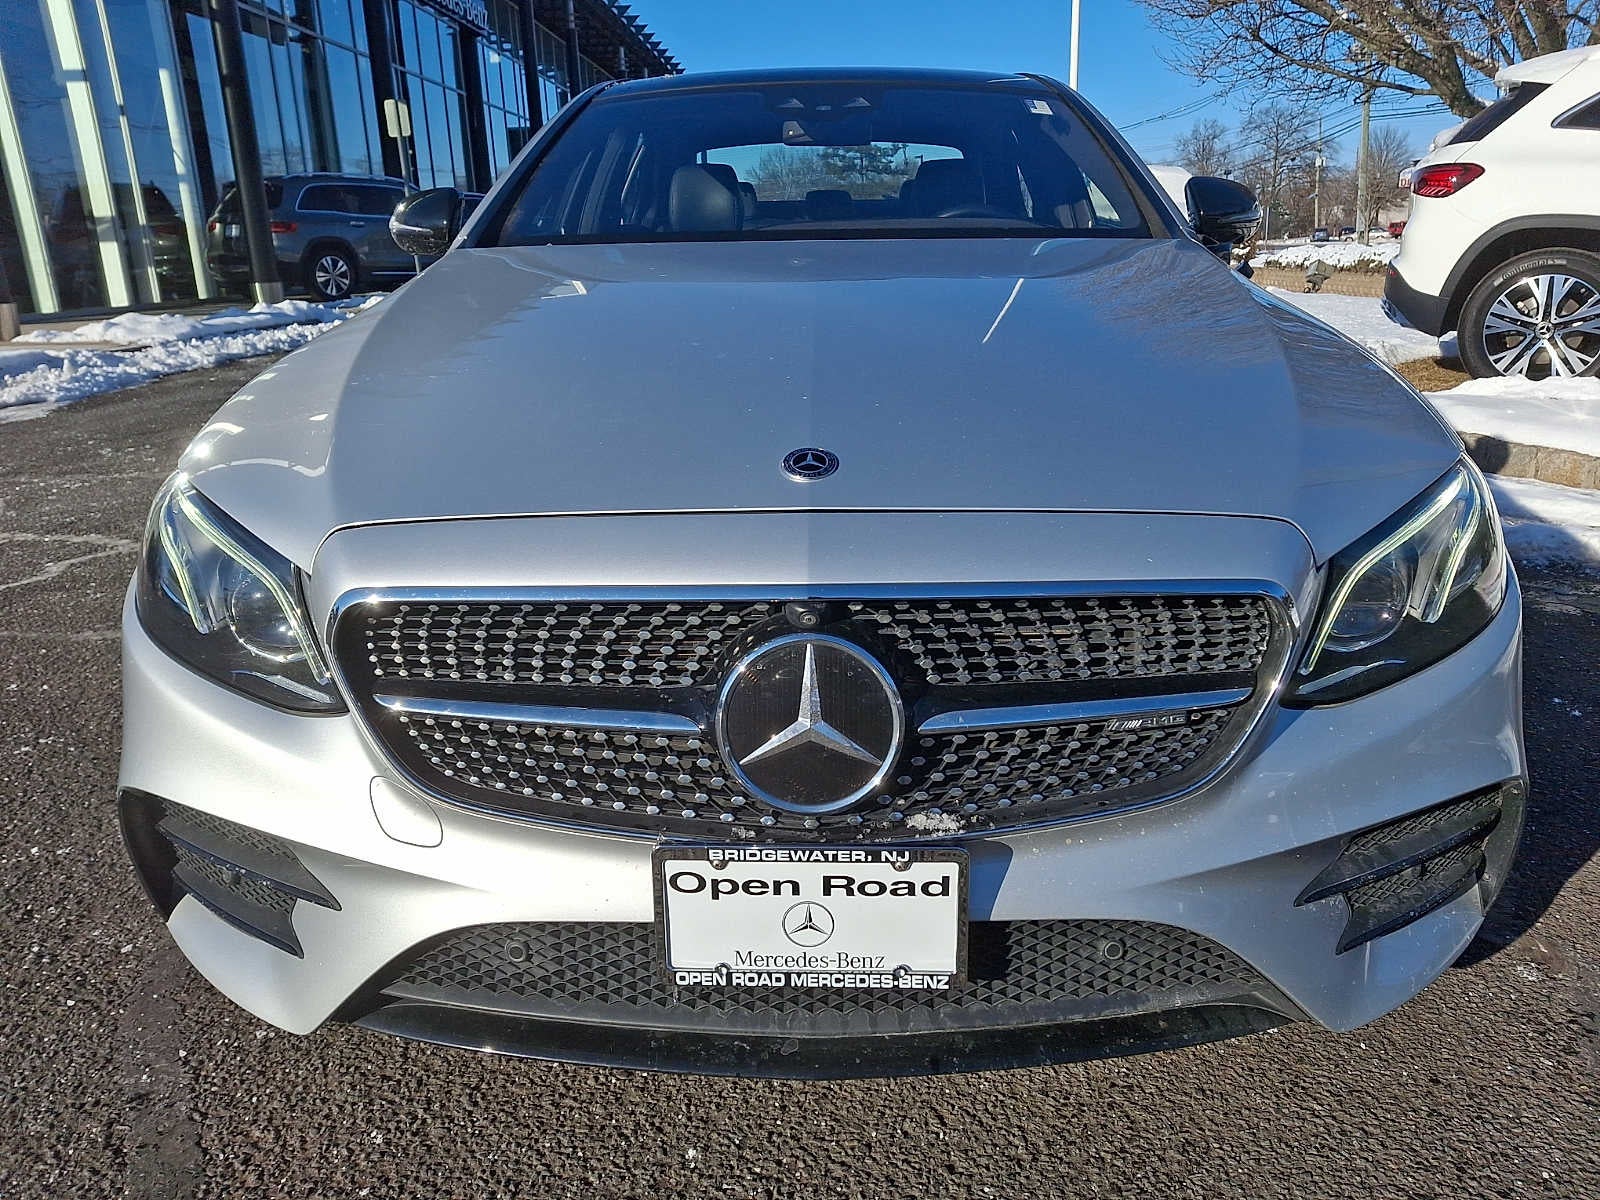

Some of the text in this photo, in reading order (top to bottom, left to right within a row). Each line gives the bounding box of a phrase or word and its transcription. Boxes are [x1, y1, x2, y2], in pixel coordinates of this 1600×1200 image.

[708, 849, 911, 862] BRIDGEWATER, NJ
[668, 871, 951, 901] Open Road
[734, 950, 886, 969] Mercedes-Benz
[675, 971, 950, 990] OPEN ROAD MERCEDES-BENZ
